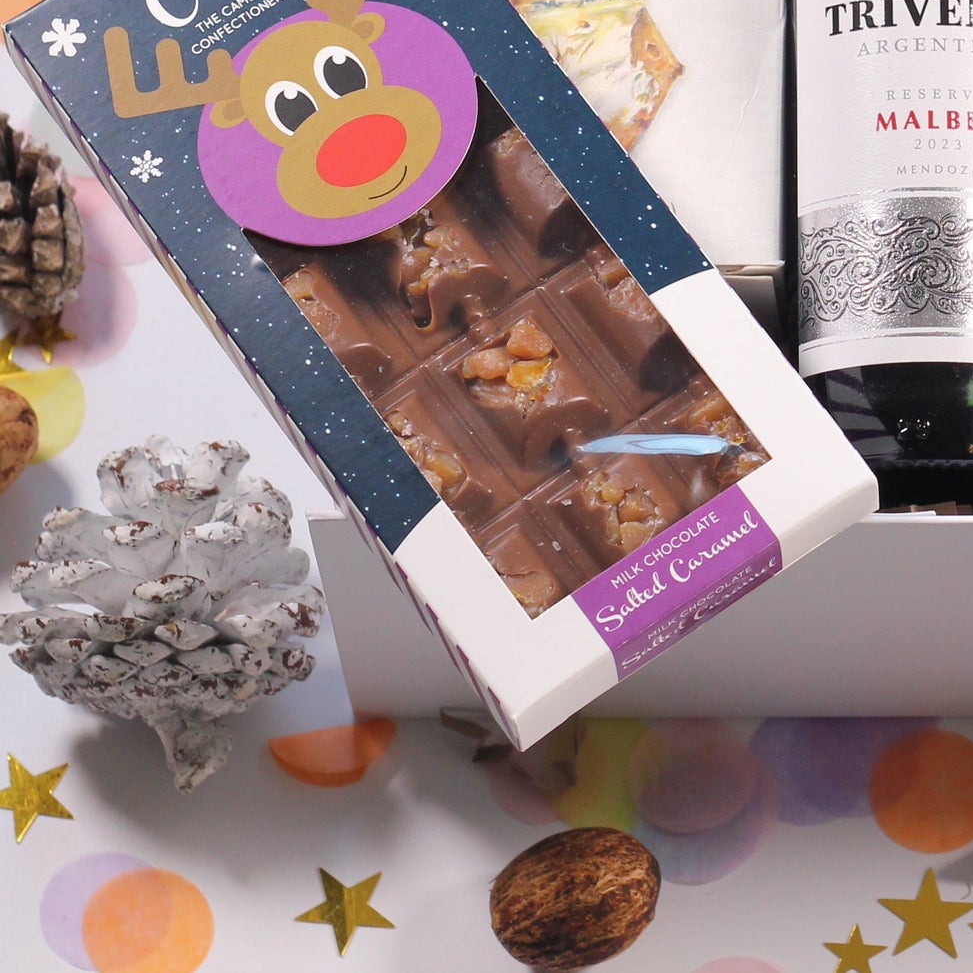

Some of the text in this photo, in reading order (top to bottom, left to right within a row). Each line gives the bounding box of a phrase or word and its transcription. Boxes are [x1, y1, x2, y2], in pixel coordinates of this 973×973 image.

[195, 12, 221, 33] THE
[914, 138, 962, 150] 2023
[596, 510, 759, 633] Salted Caramel
[610, 511, 720, 589] MILK CHOCOLATE
[621, 557, 777, 669] Salted Caramel
[647, 566, 753, 640] MILK CHOCOLATE
